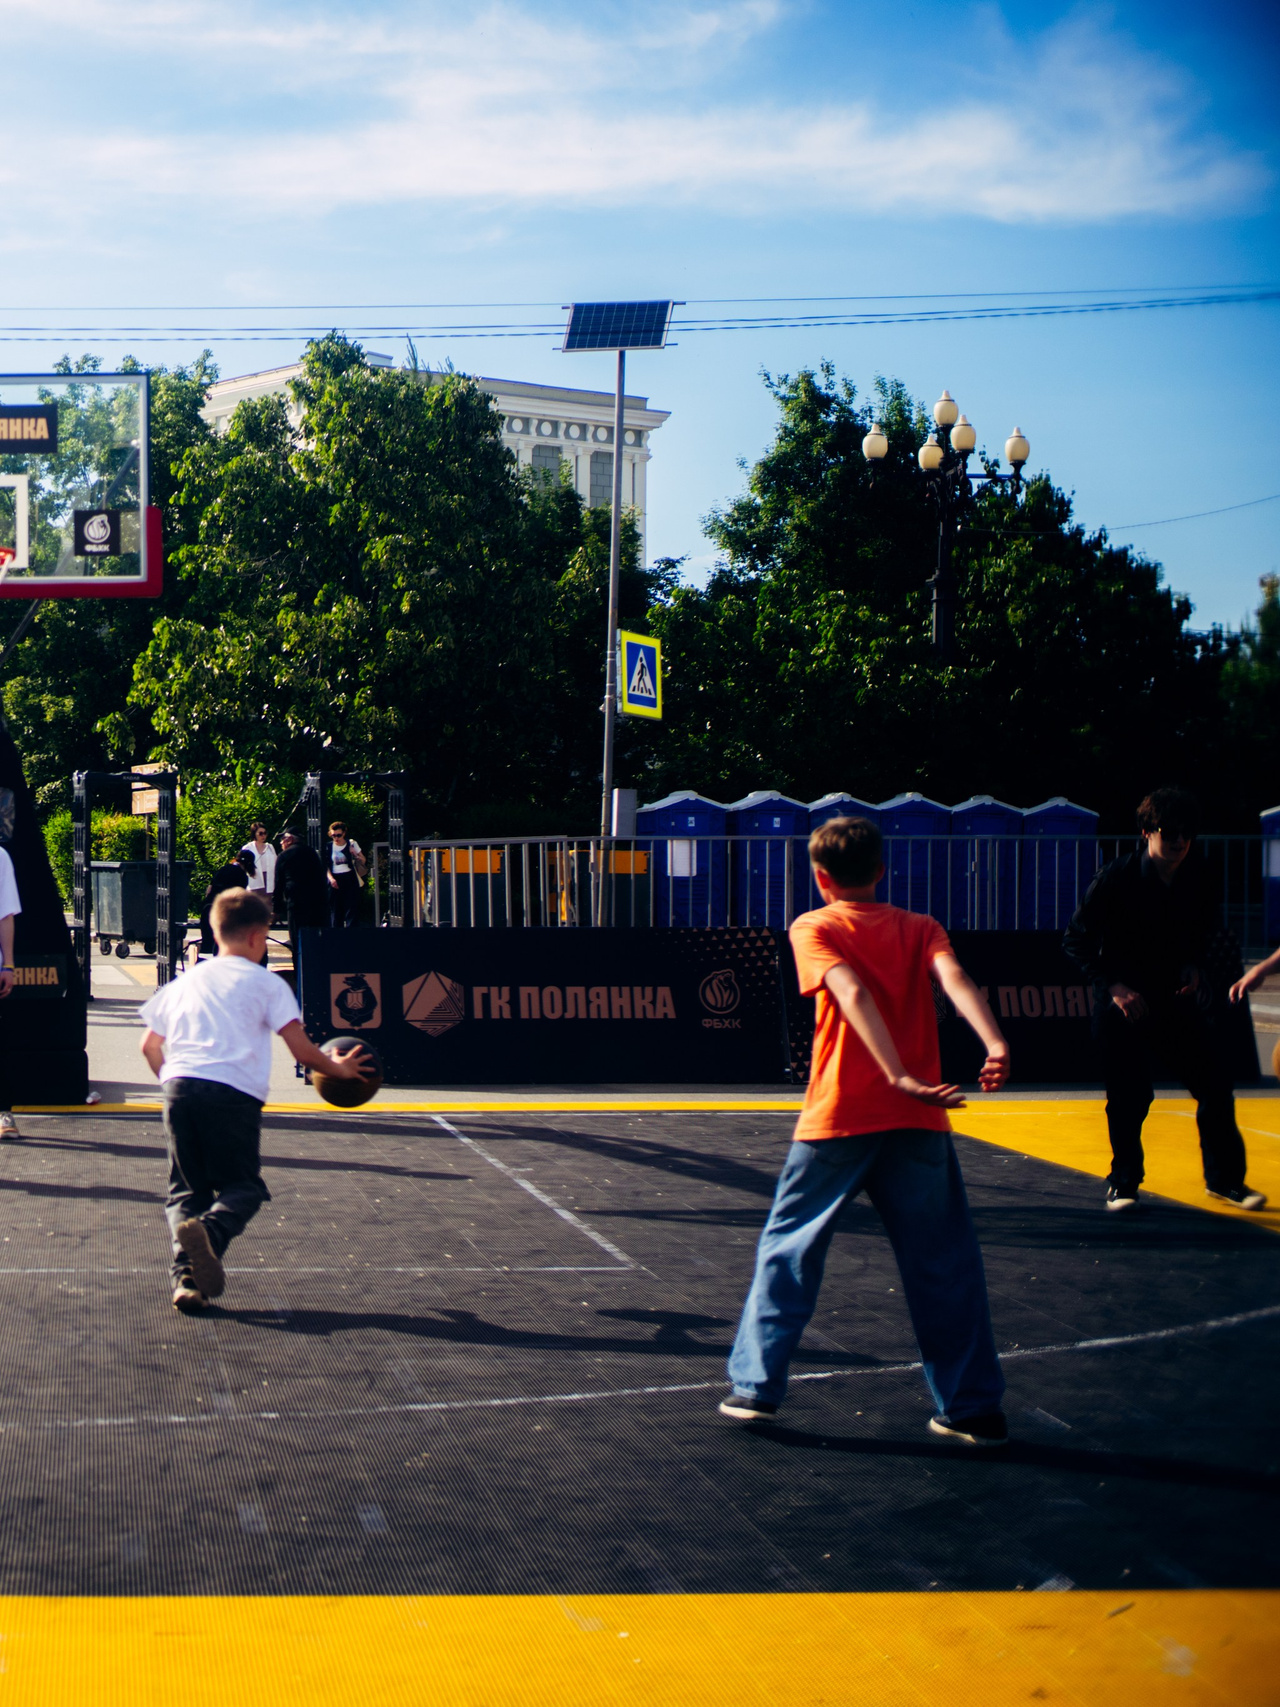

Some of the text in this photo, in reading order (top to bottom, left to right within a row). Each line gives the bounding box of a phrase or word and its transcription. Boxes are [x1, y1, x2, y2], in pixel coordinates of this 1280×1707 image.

[13, 967, 59, 985] ЯНКА
[472, 985, 677, 1020] ГК ПОЛЯНКА
[997, 985, 1095, 1018] ПОЛЯ
[701, 1018, 742, 1029] ФБХК
